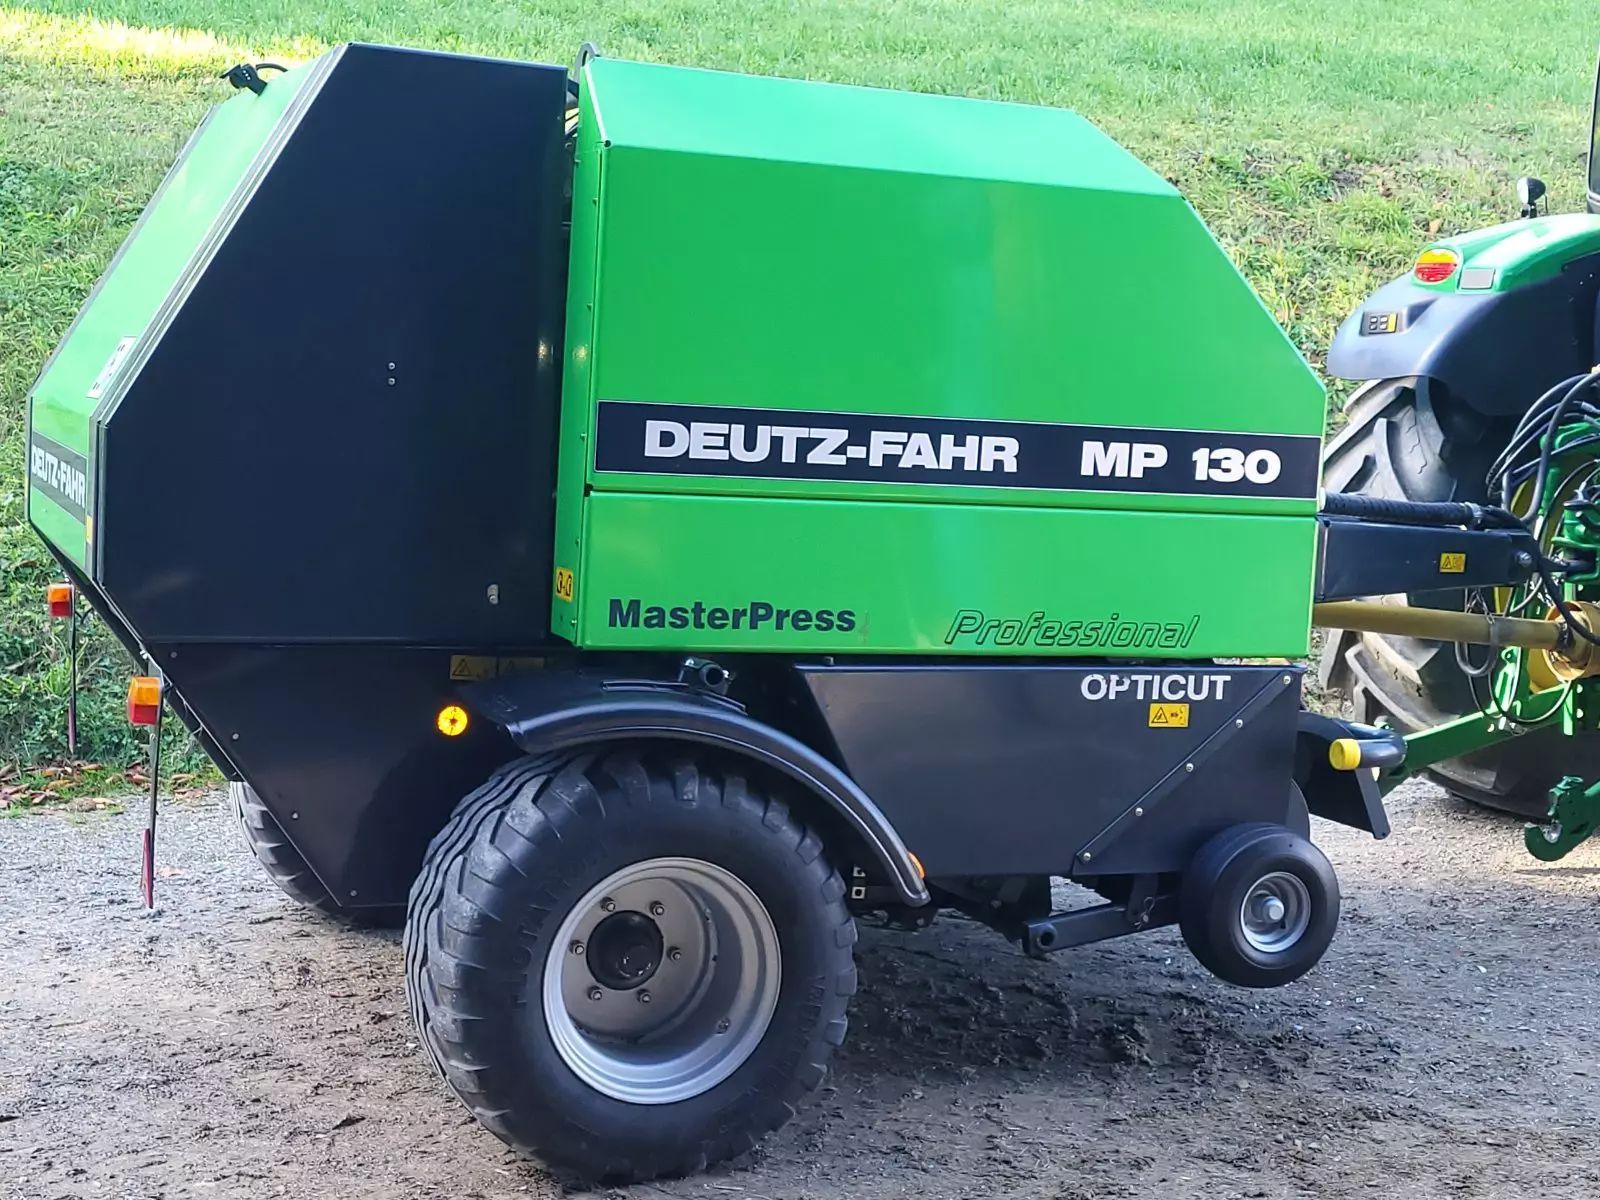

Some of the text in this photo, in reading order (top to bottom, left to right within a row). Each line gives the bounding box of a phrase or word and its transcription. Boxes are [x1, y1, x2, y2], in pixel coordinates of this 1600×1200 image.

[644, 420, 1282, 484] DEUTZ-FAHR MP 130
[31, 444, 86, 509] DEUTZ-FAHR
[608, 598, 857, 632] MasterPress
[944, 609, 1201, 649] Professional
[1080, 673, 1232, 701] OPTICUT
